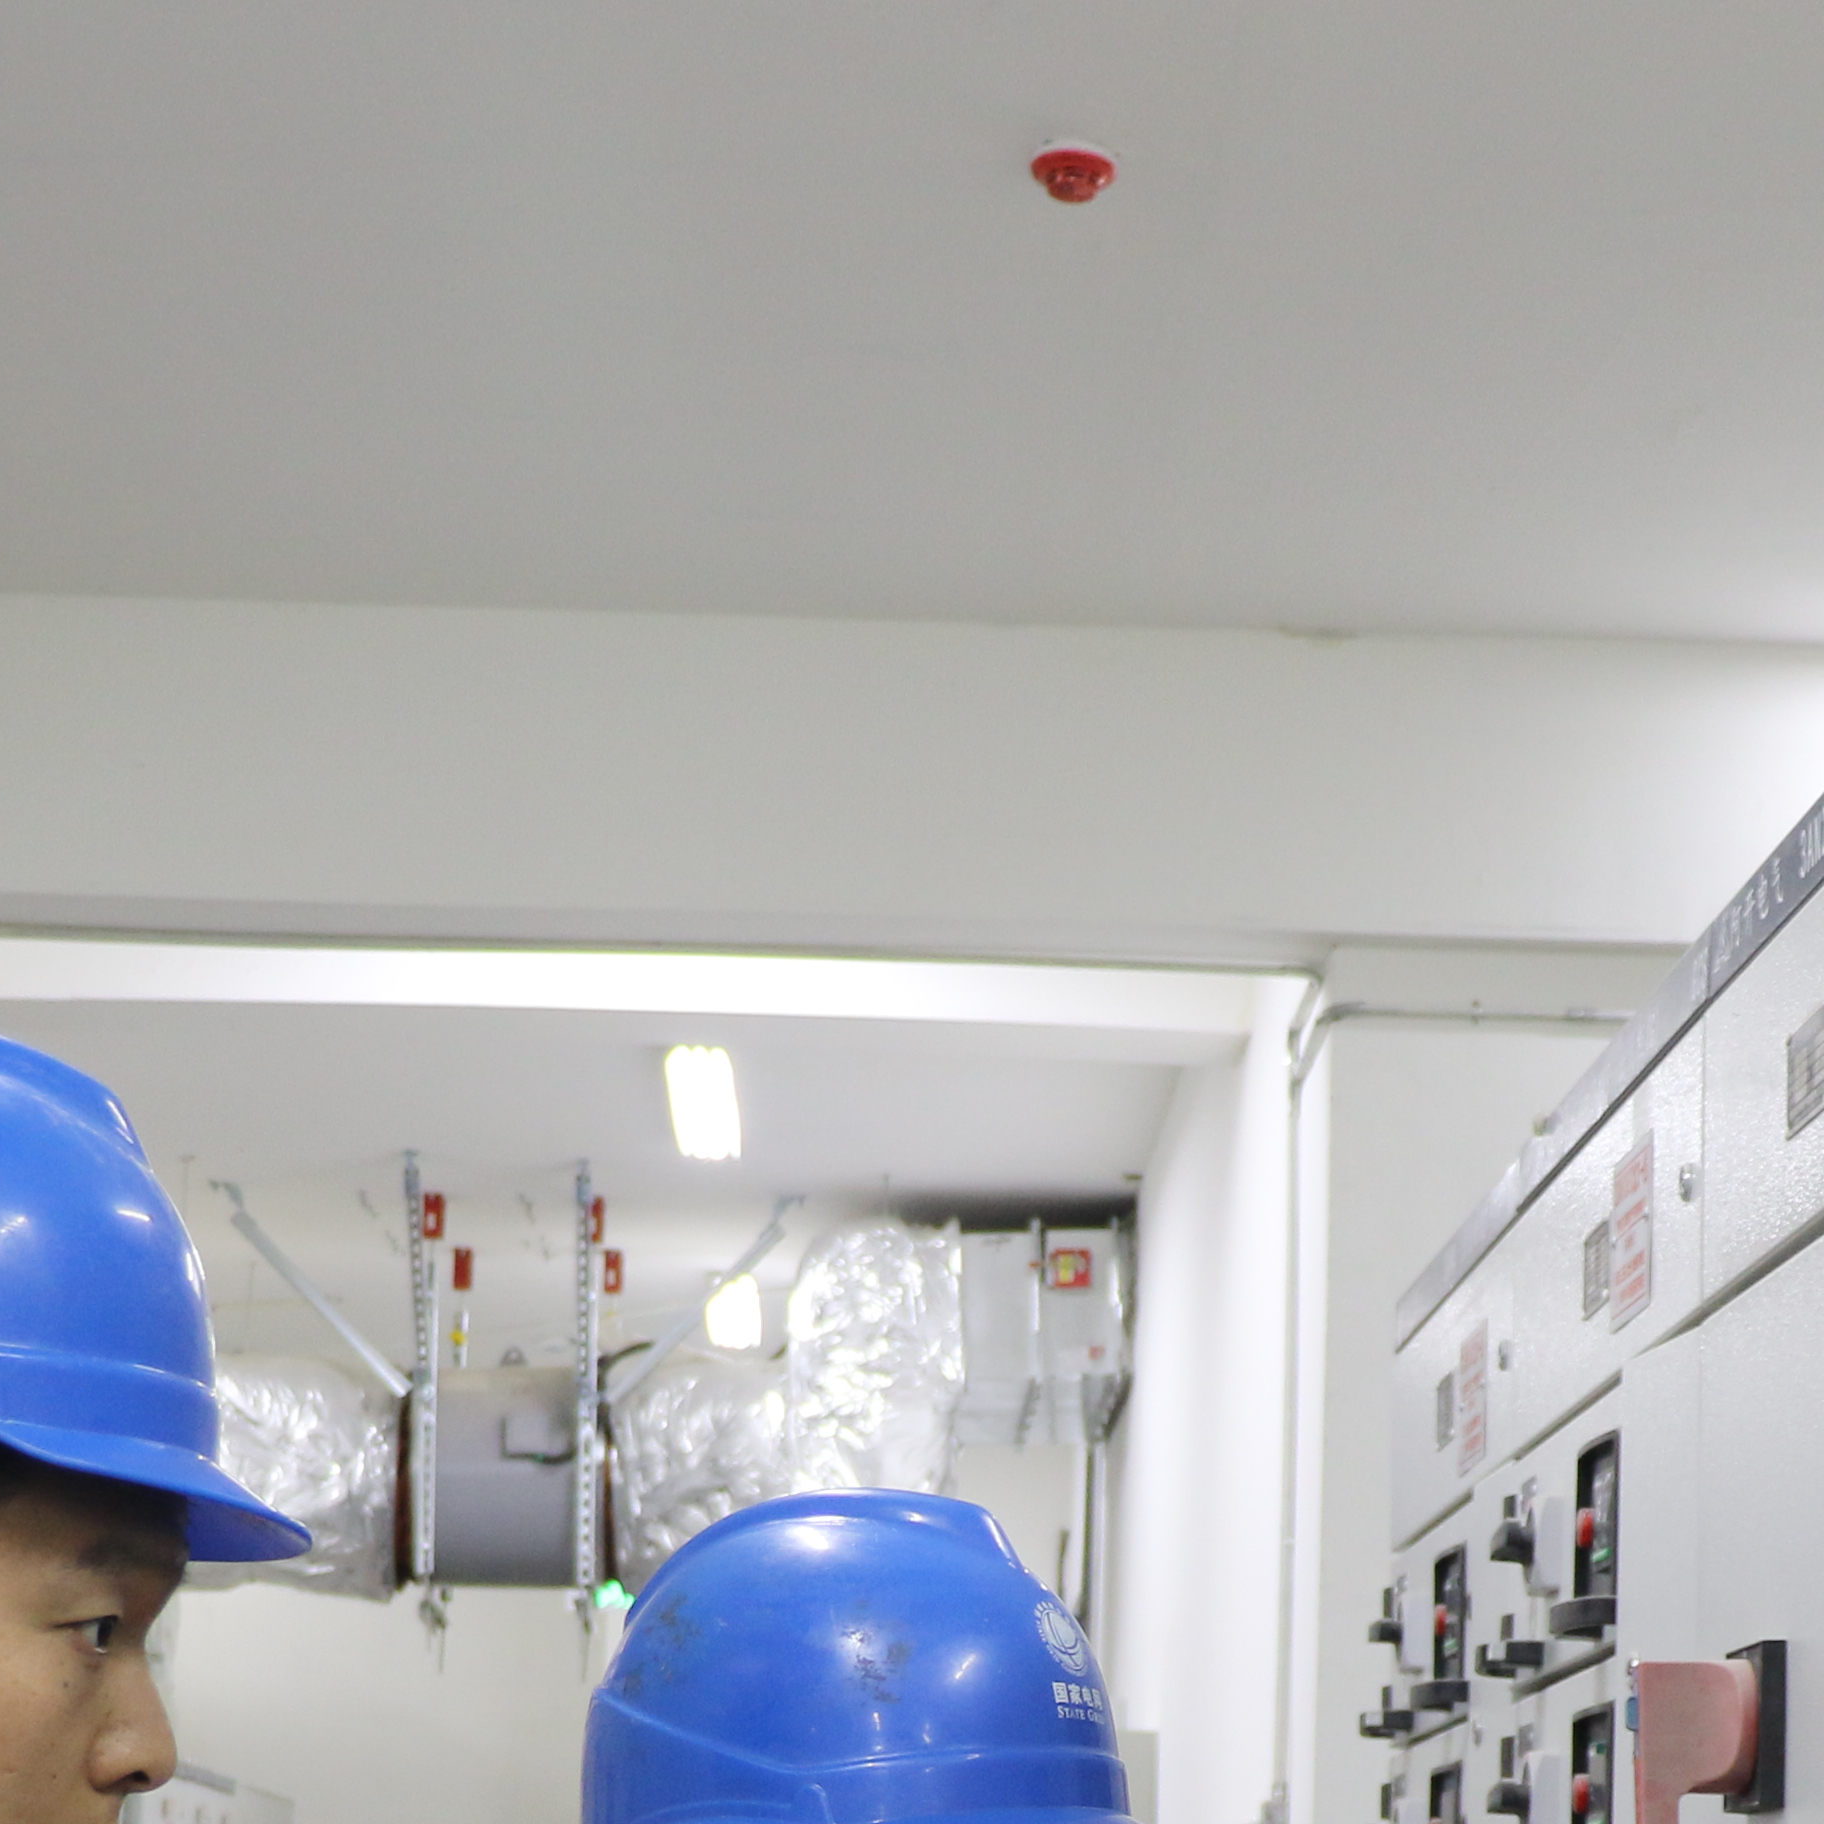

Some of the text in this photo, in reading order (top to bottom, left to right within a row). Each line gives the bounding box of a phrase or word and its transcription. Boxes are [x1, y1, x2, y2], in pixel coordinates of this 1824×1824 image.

[1052, 1681, 1104, 1712] 国家电网
[1057, 1705, 1086, 1721] STATE
